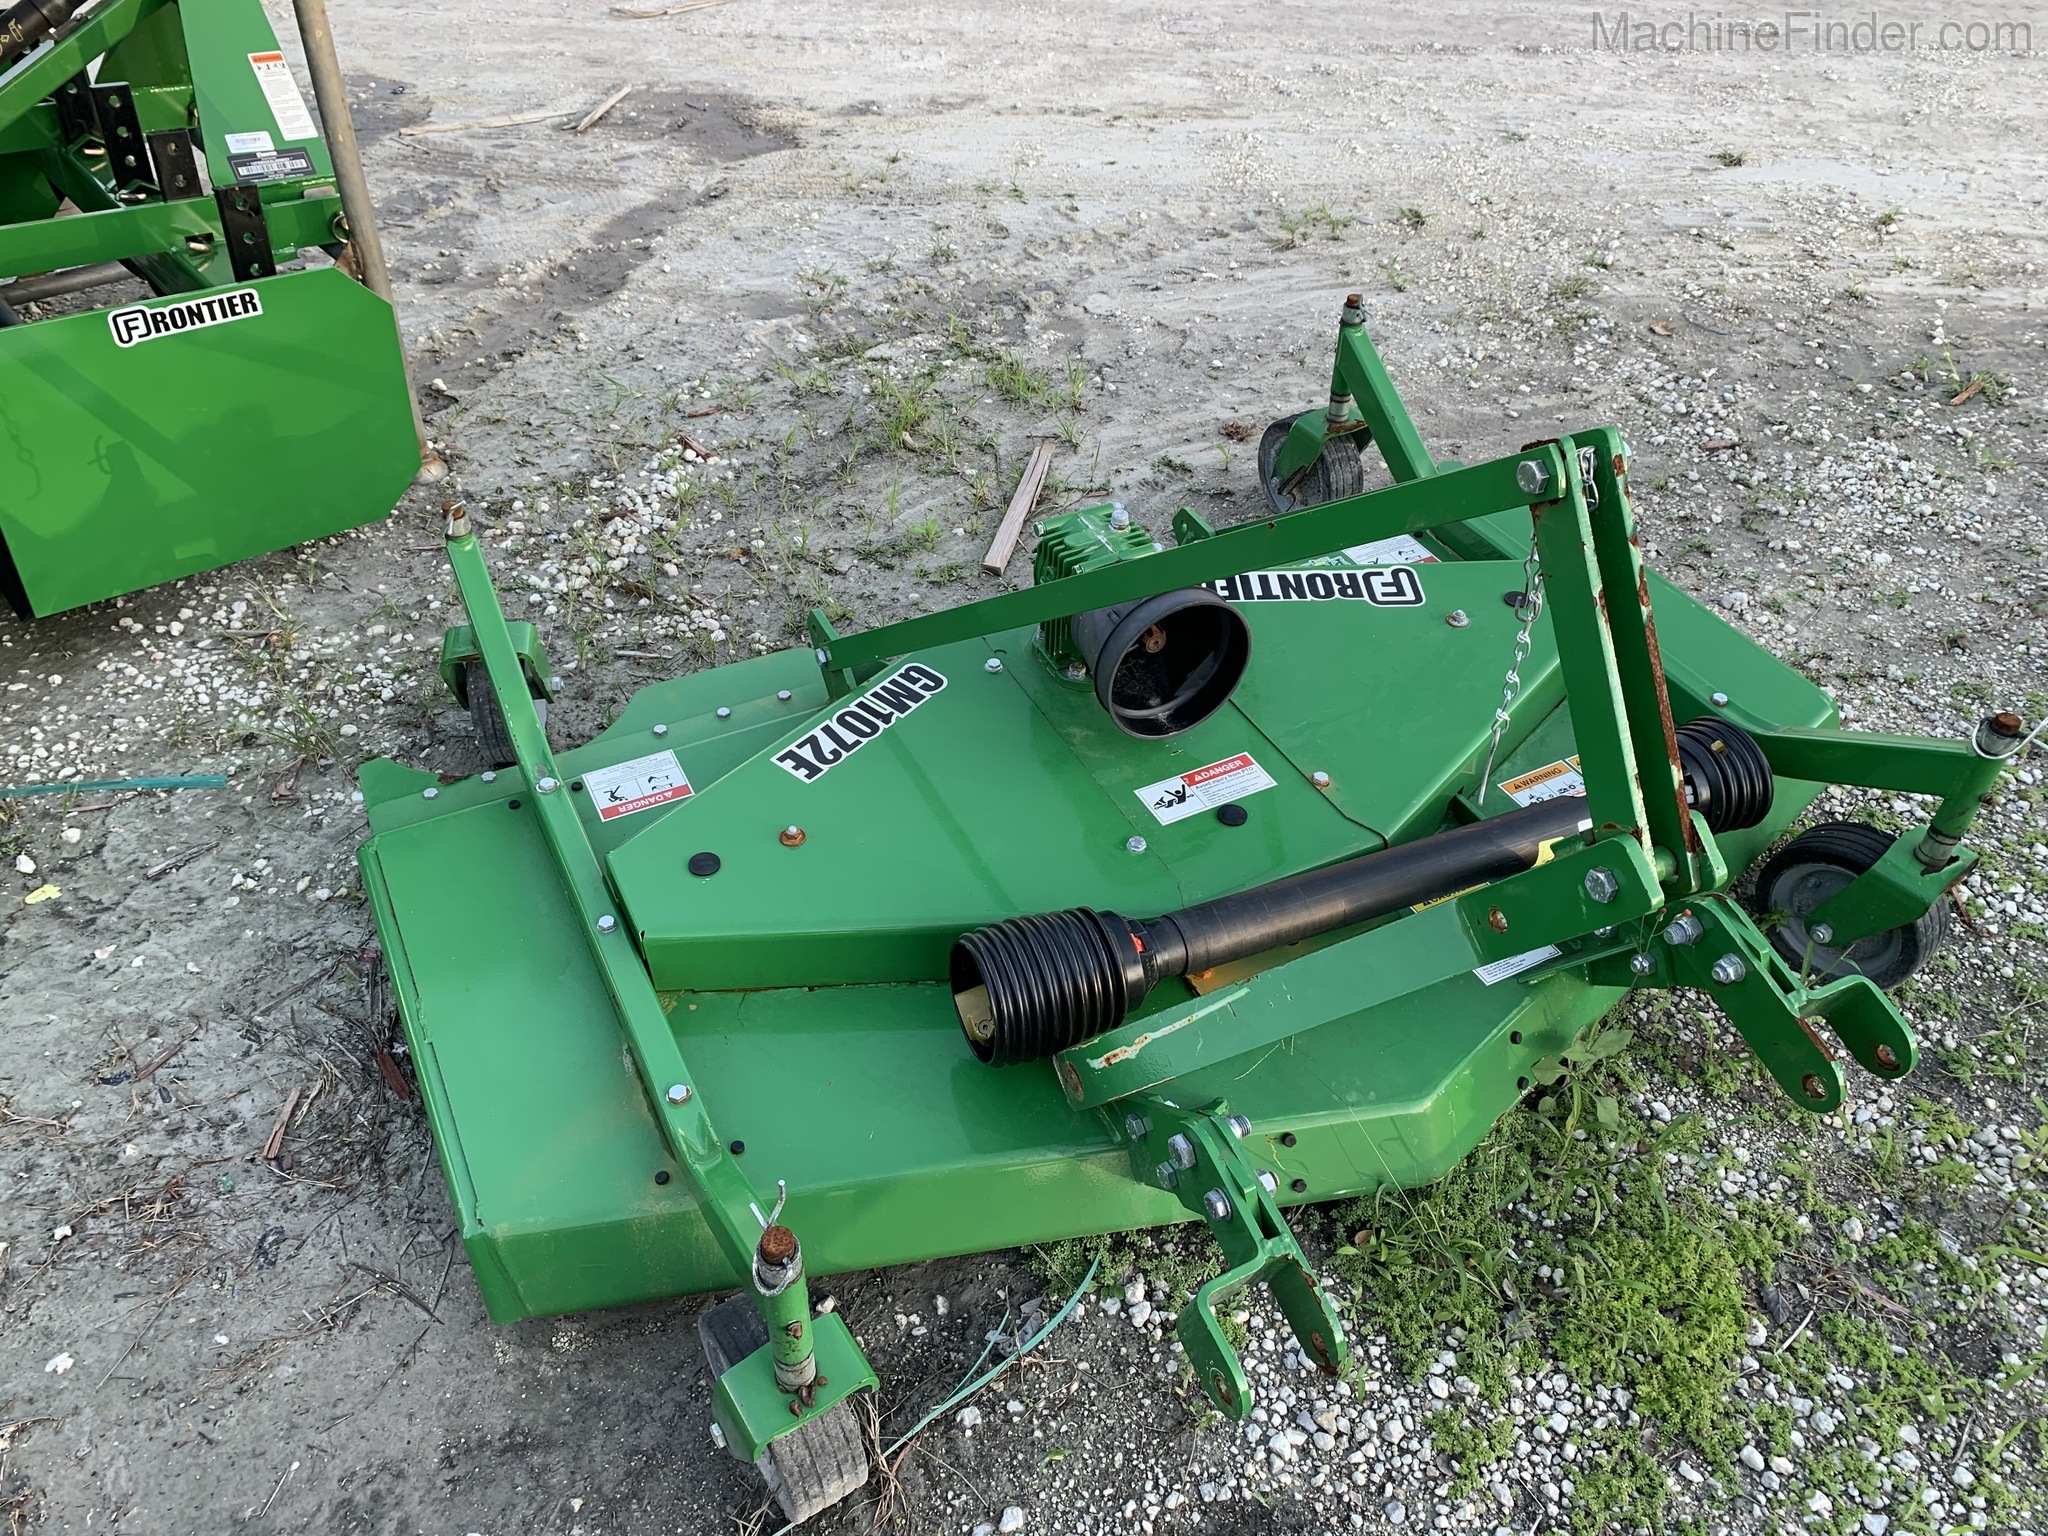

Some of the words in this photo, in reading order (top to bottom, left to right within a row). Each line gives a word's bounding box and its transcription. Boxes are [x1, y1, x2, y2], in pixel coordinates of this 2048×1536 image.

[112, 291, 259, 345] FRONTIER
[1204, 567, 1424, 605] FRONTIE
[776, 665, 945, 780] GM1072E
[1200, 759, 1244, 779] DANGER
[1519, 767, 1562, 788] WARNING
[617, 795, 665, 815] DANGER
